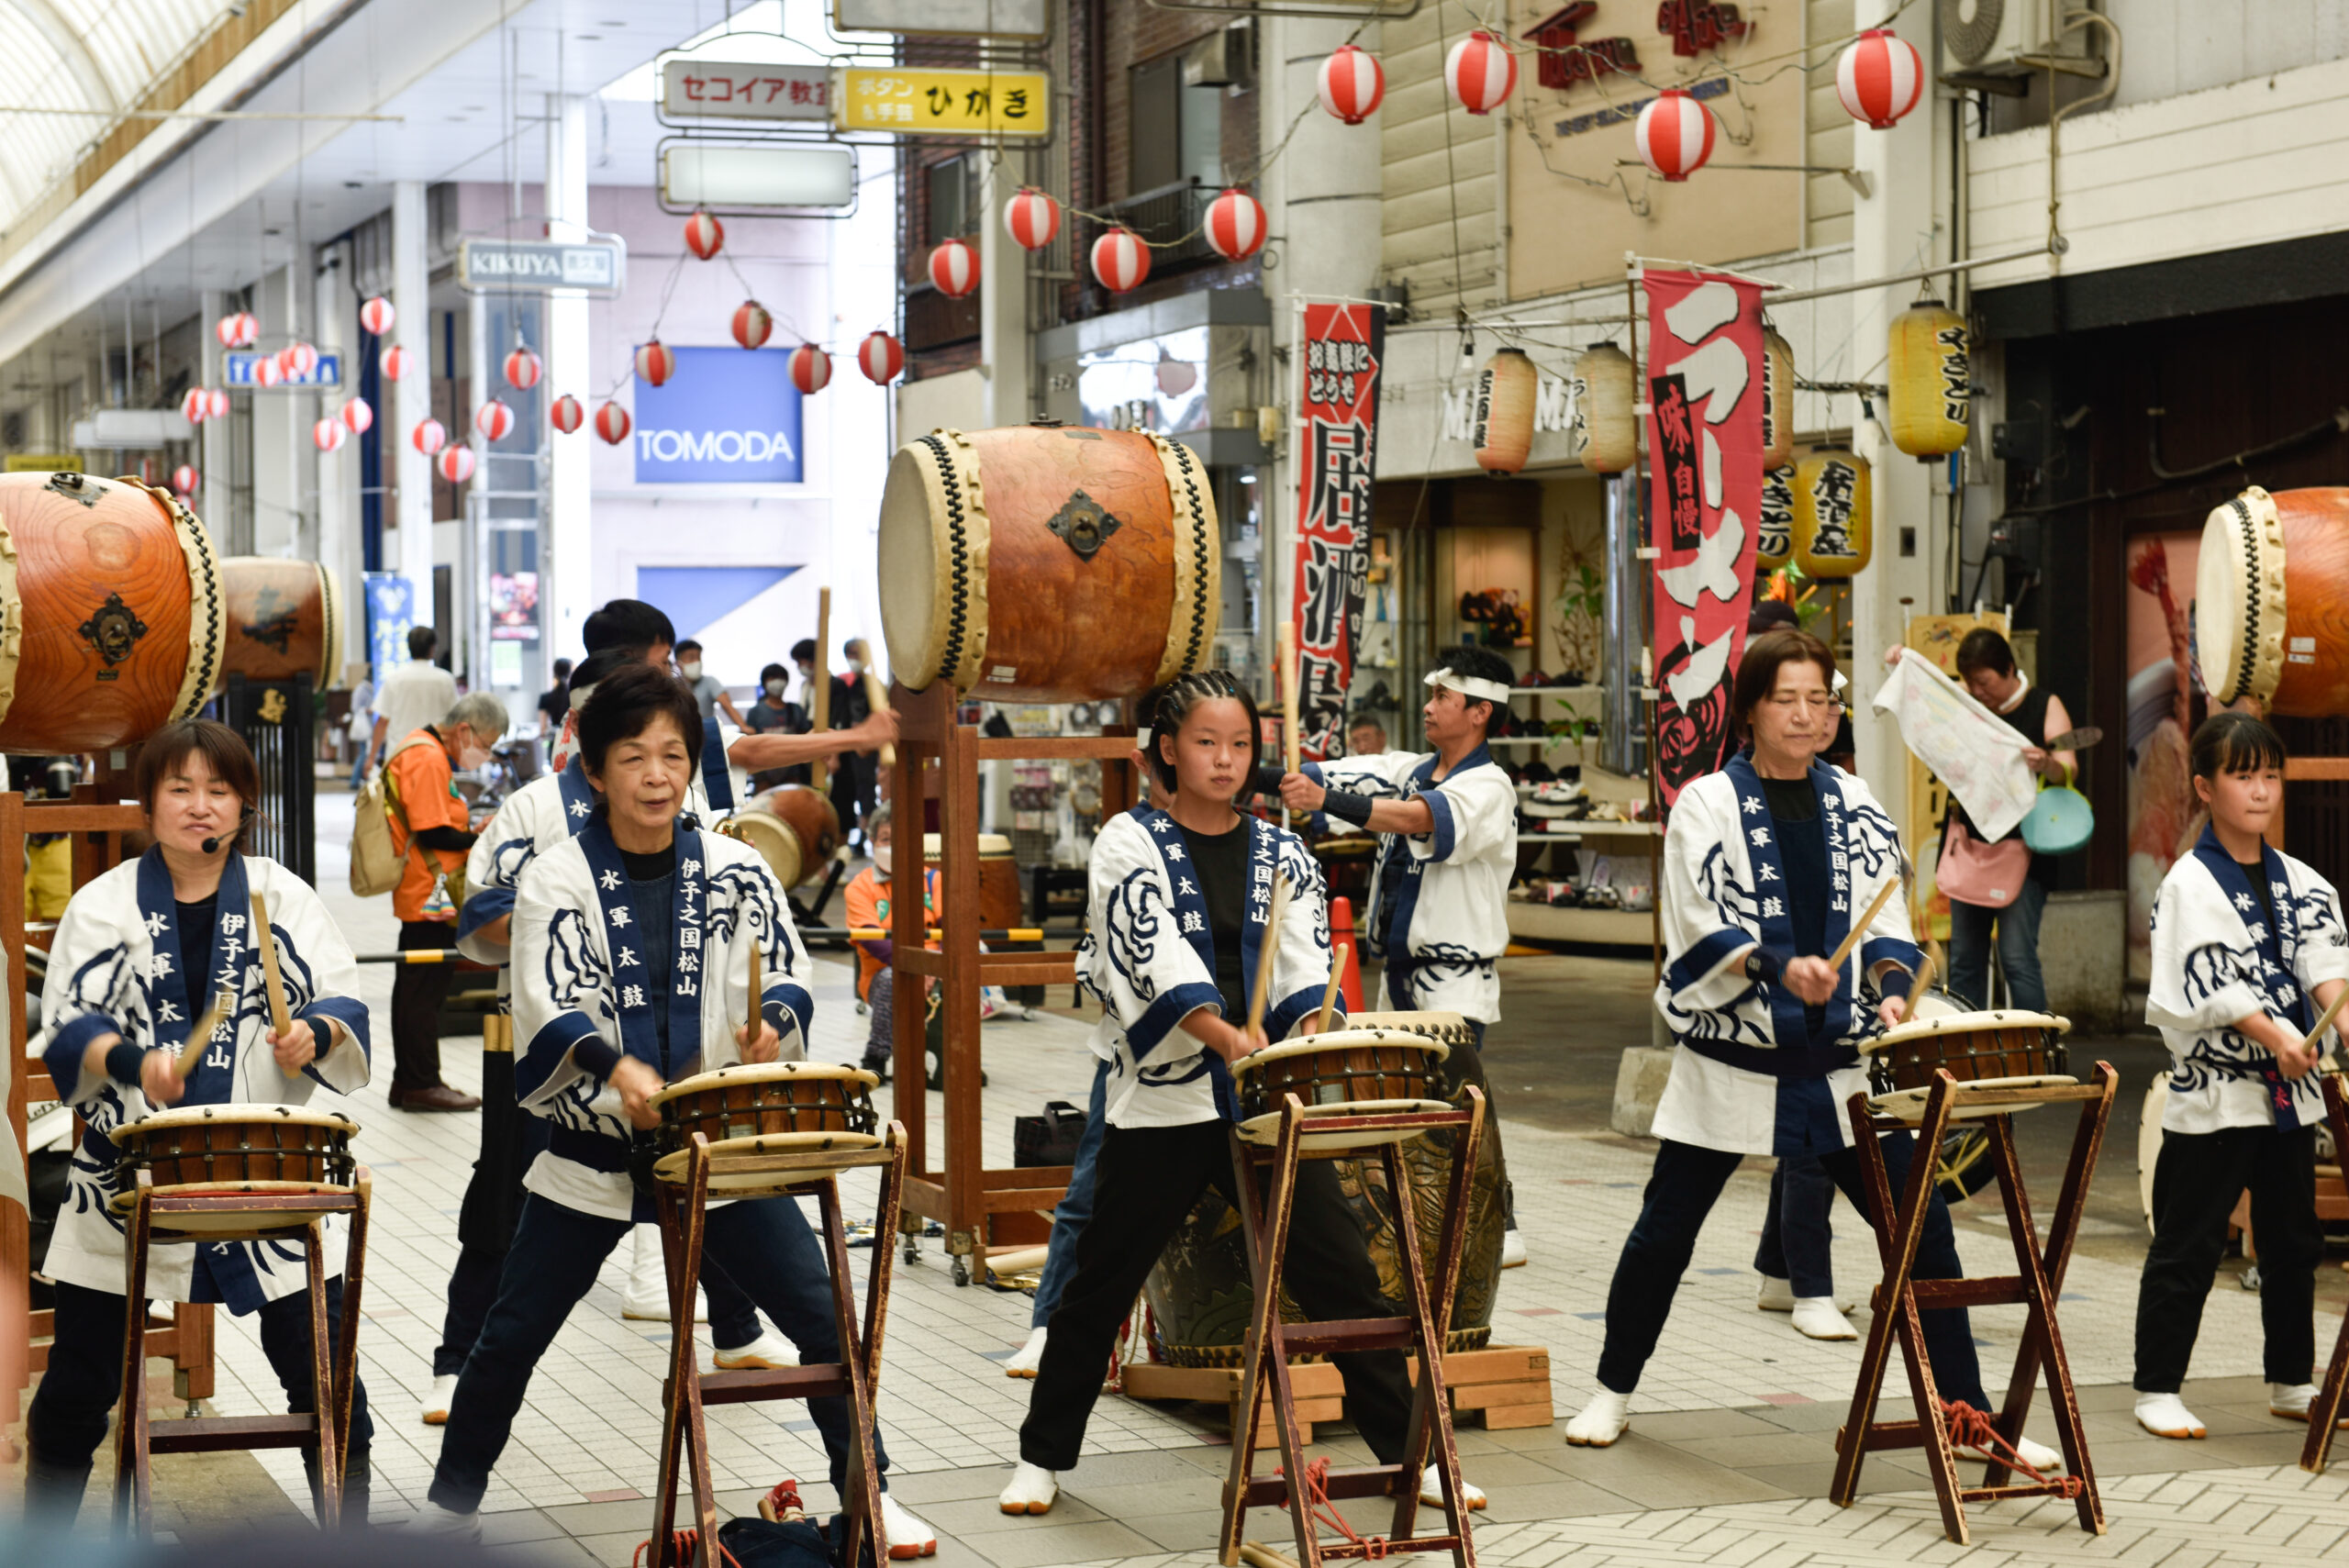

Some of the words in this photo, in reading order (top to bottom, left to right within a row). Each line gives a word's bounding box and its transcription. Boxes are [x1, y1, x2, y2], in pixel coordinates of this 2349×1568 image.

[473, 253, 562, 275] KIKUYA
[638, 430, 795, 462] TOMODA
[1658, 382, 1700, 539] 味自慢
[1810, 460, 1859, 557] 居酒屋
[1151, 817, 1207, 933] 水軍太鼓
[1742, 795, 1786, 919] 水軍太鼓
[599, 869, 648, 1009] 水軍太鼓
